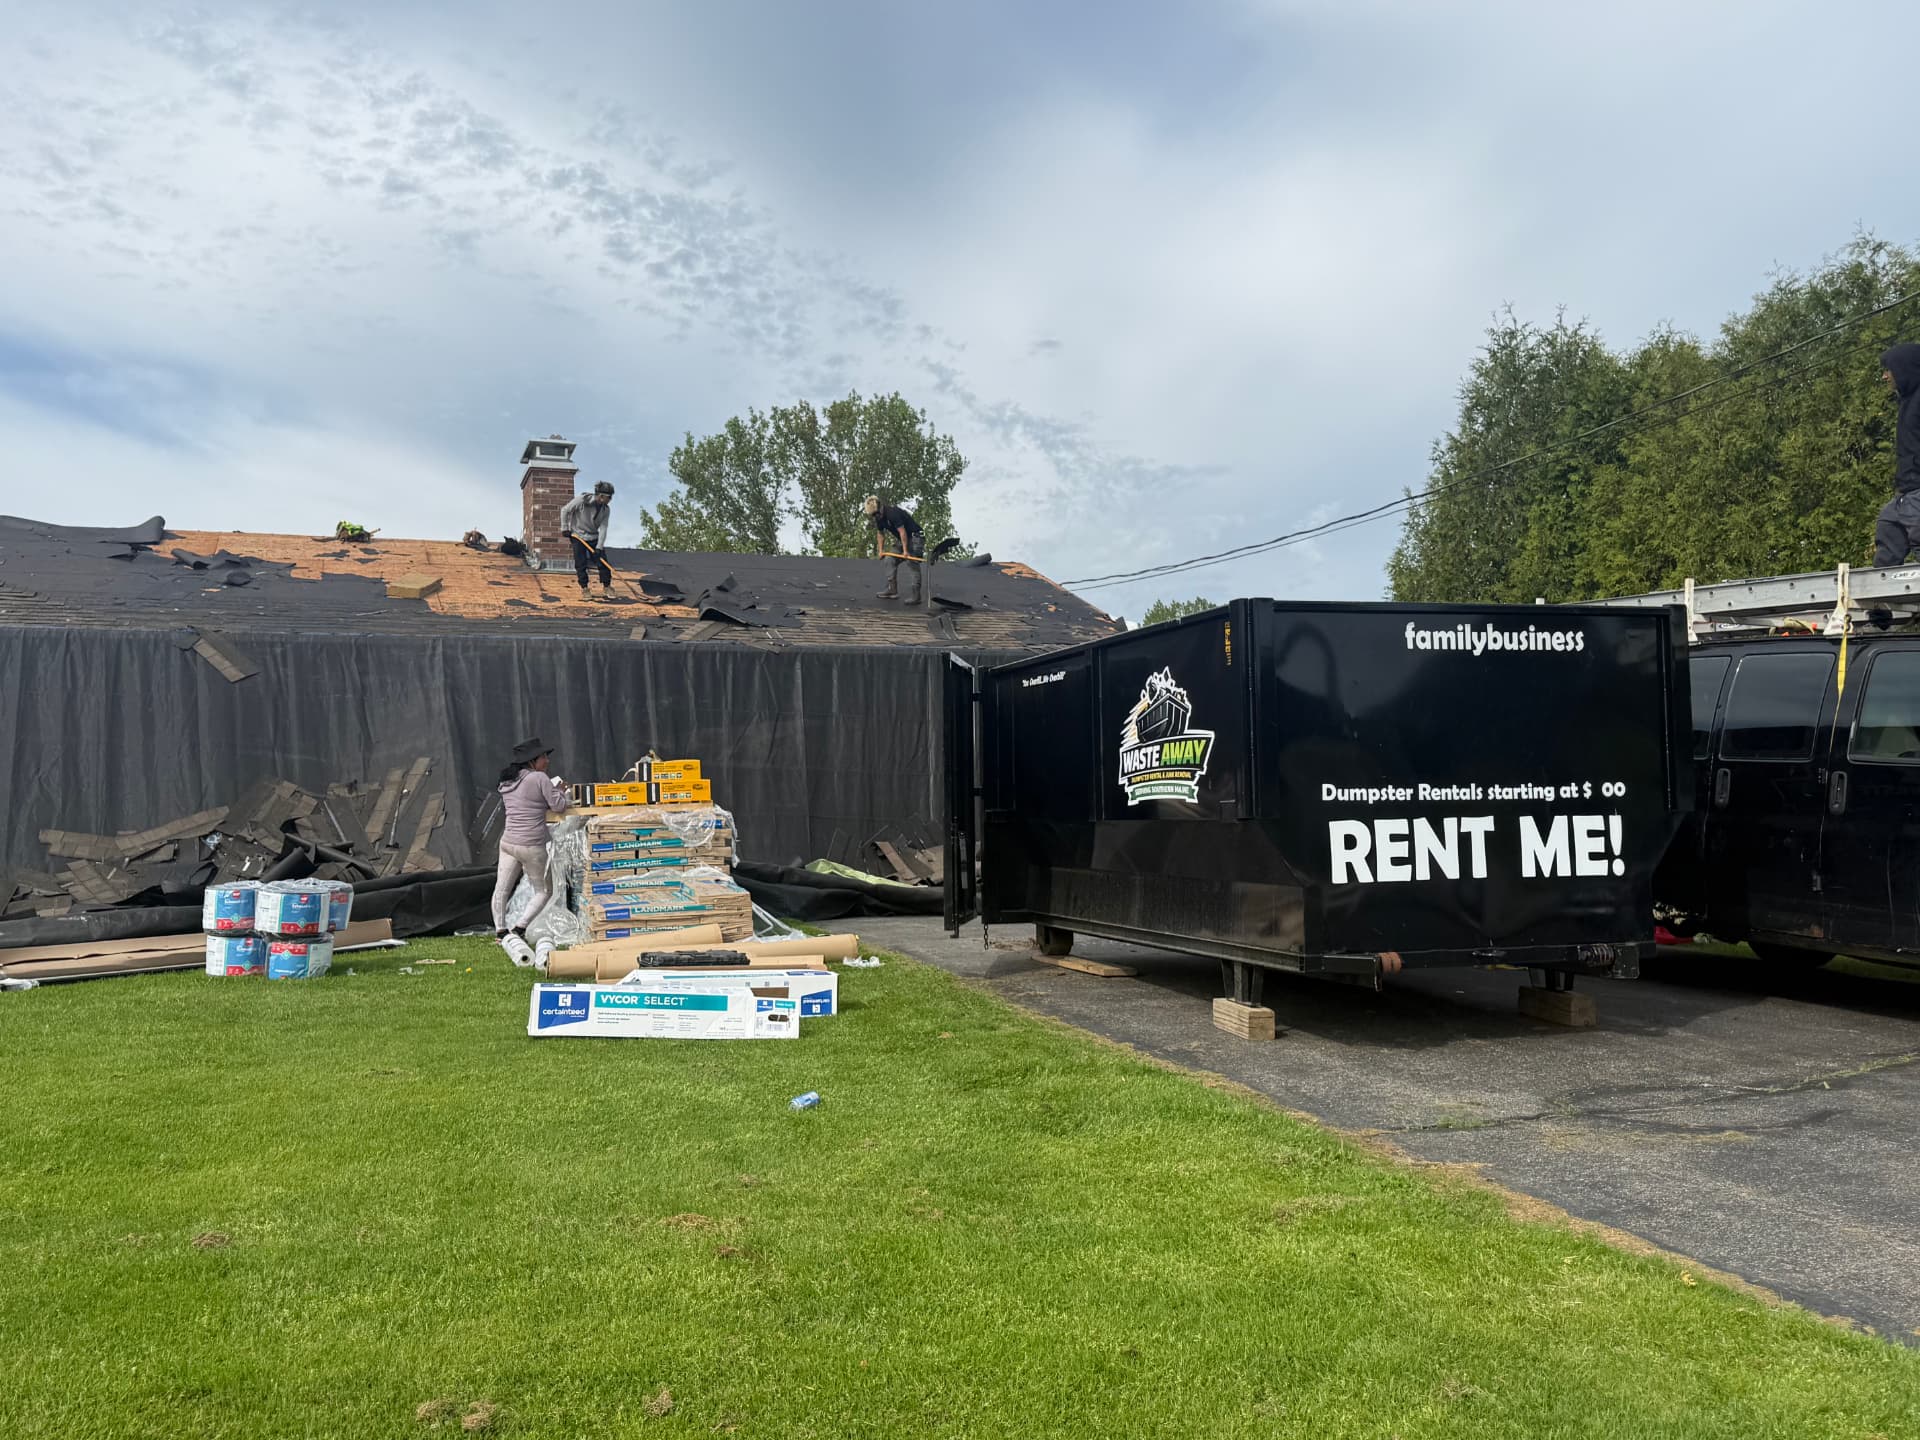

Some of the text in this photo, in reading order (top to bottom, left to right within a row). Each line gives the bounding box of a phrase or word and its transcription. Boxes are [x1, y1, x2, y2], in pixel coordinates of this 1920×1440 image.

[1404, 622, 1585, 656] familybusiness
[1123, 740, 1207, 773] WASTE AWAY
[1321, 783, 1413, 804] Dumpster
[1418, 783, 1483, 800] Rentals
[1487, 782, 1554, 801] starting
[1560, 782, 1579, 798] at
[1583, 782, 1592, 799] $
[618, 840, 662, 849] LANDMARK
[1328, 814, 1626, 884] RENT ME!
[635, 904, 685, 913] LANDMARK
